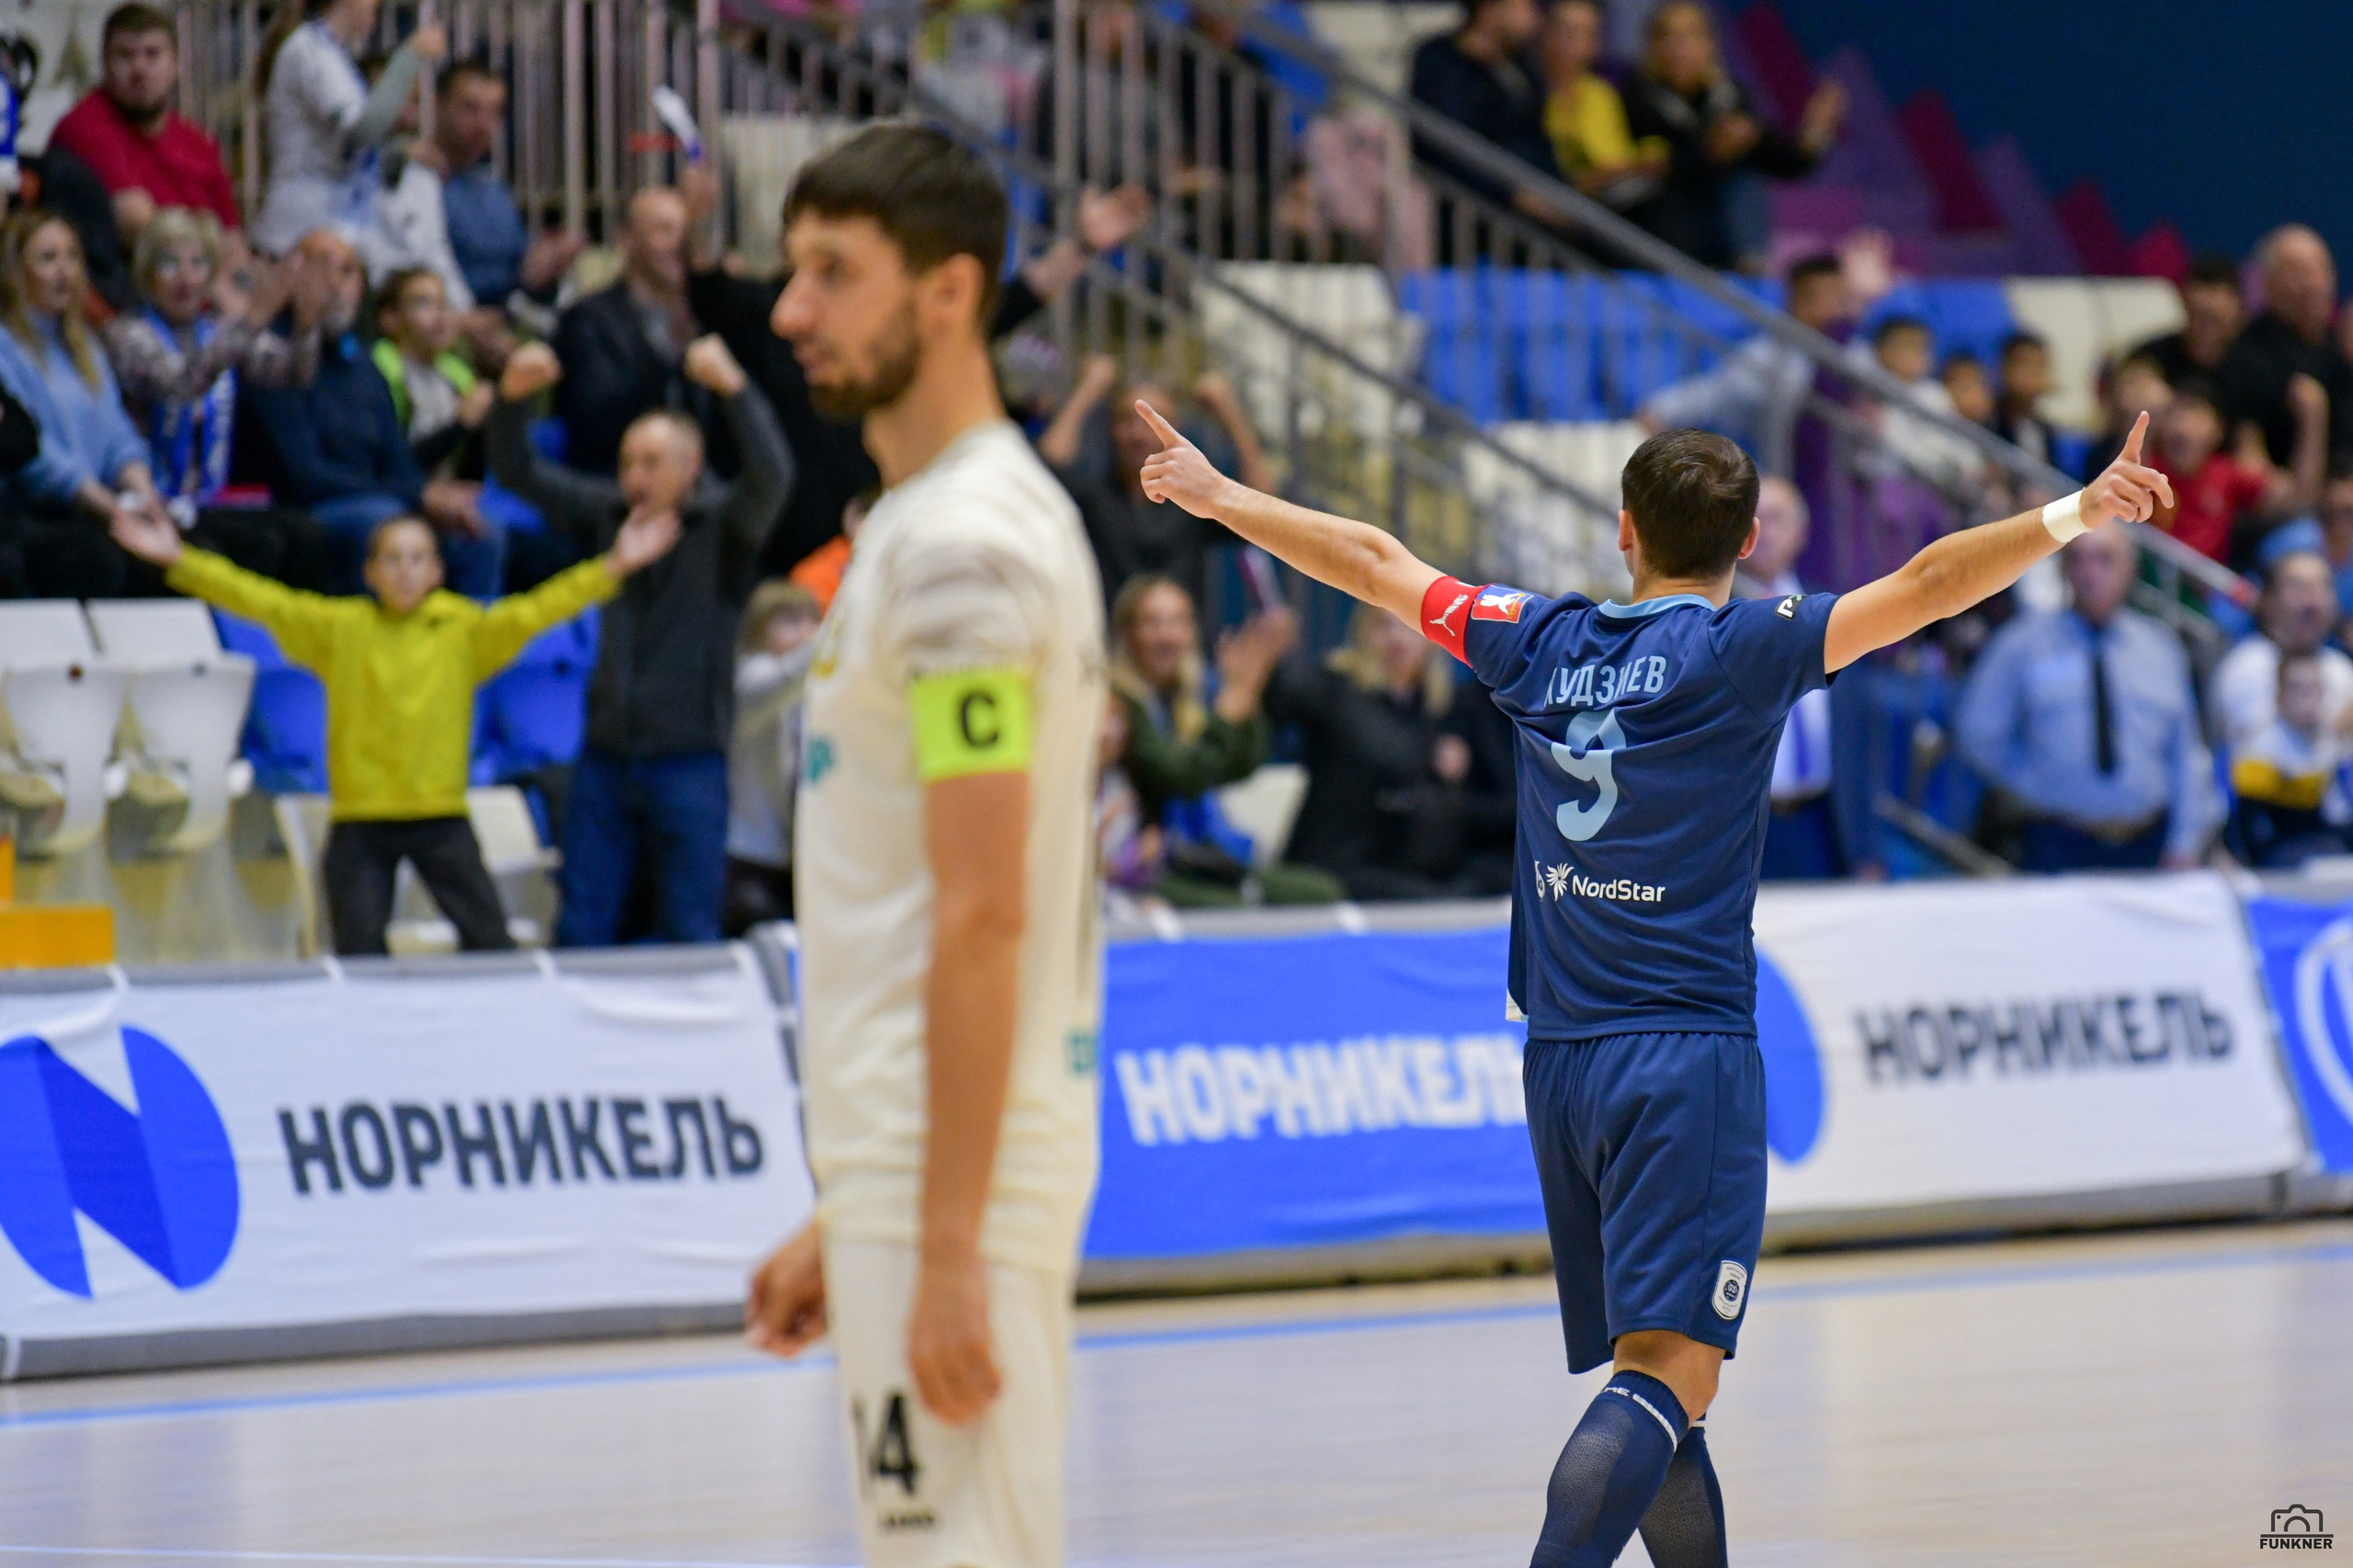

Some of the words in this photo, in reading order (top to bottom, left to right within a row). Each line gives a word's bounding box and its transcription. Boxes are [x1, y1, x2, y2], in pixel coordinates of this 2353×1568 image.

[959, 689, 1000, 750] C
[1551, 707, 1627, 842] 9
[1572, 875, 1665, 903] NordStar
[1854, 988, 2235, 1085] НОРНИКЕЛЬ
[278, 1096, 765, 1195] НОРНИКЕЛЬ
